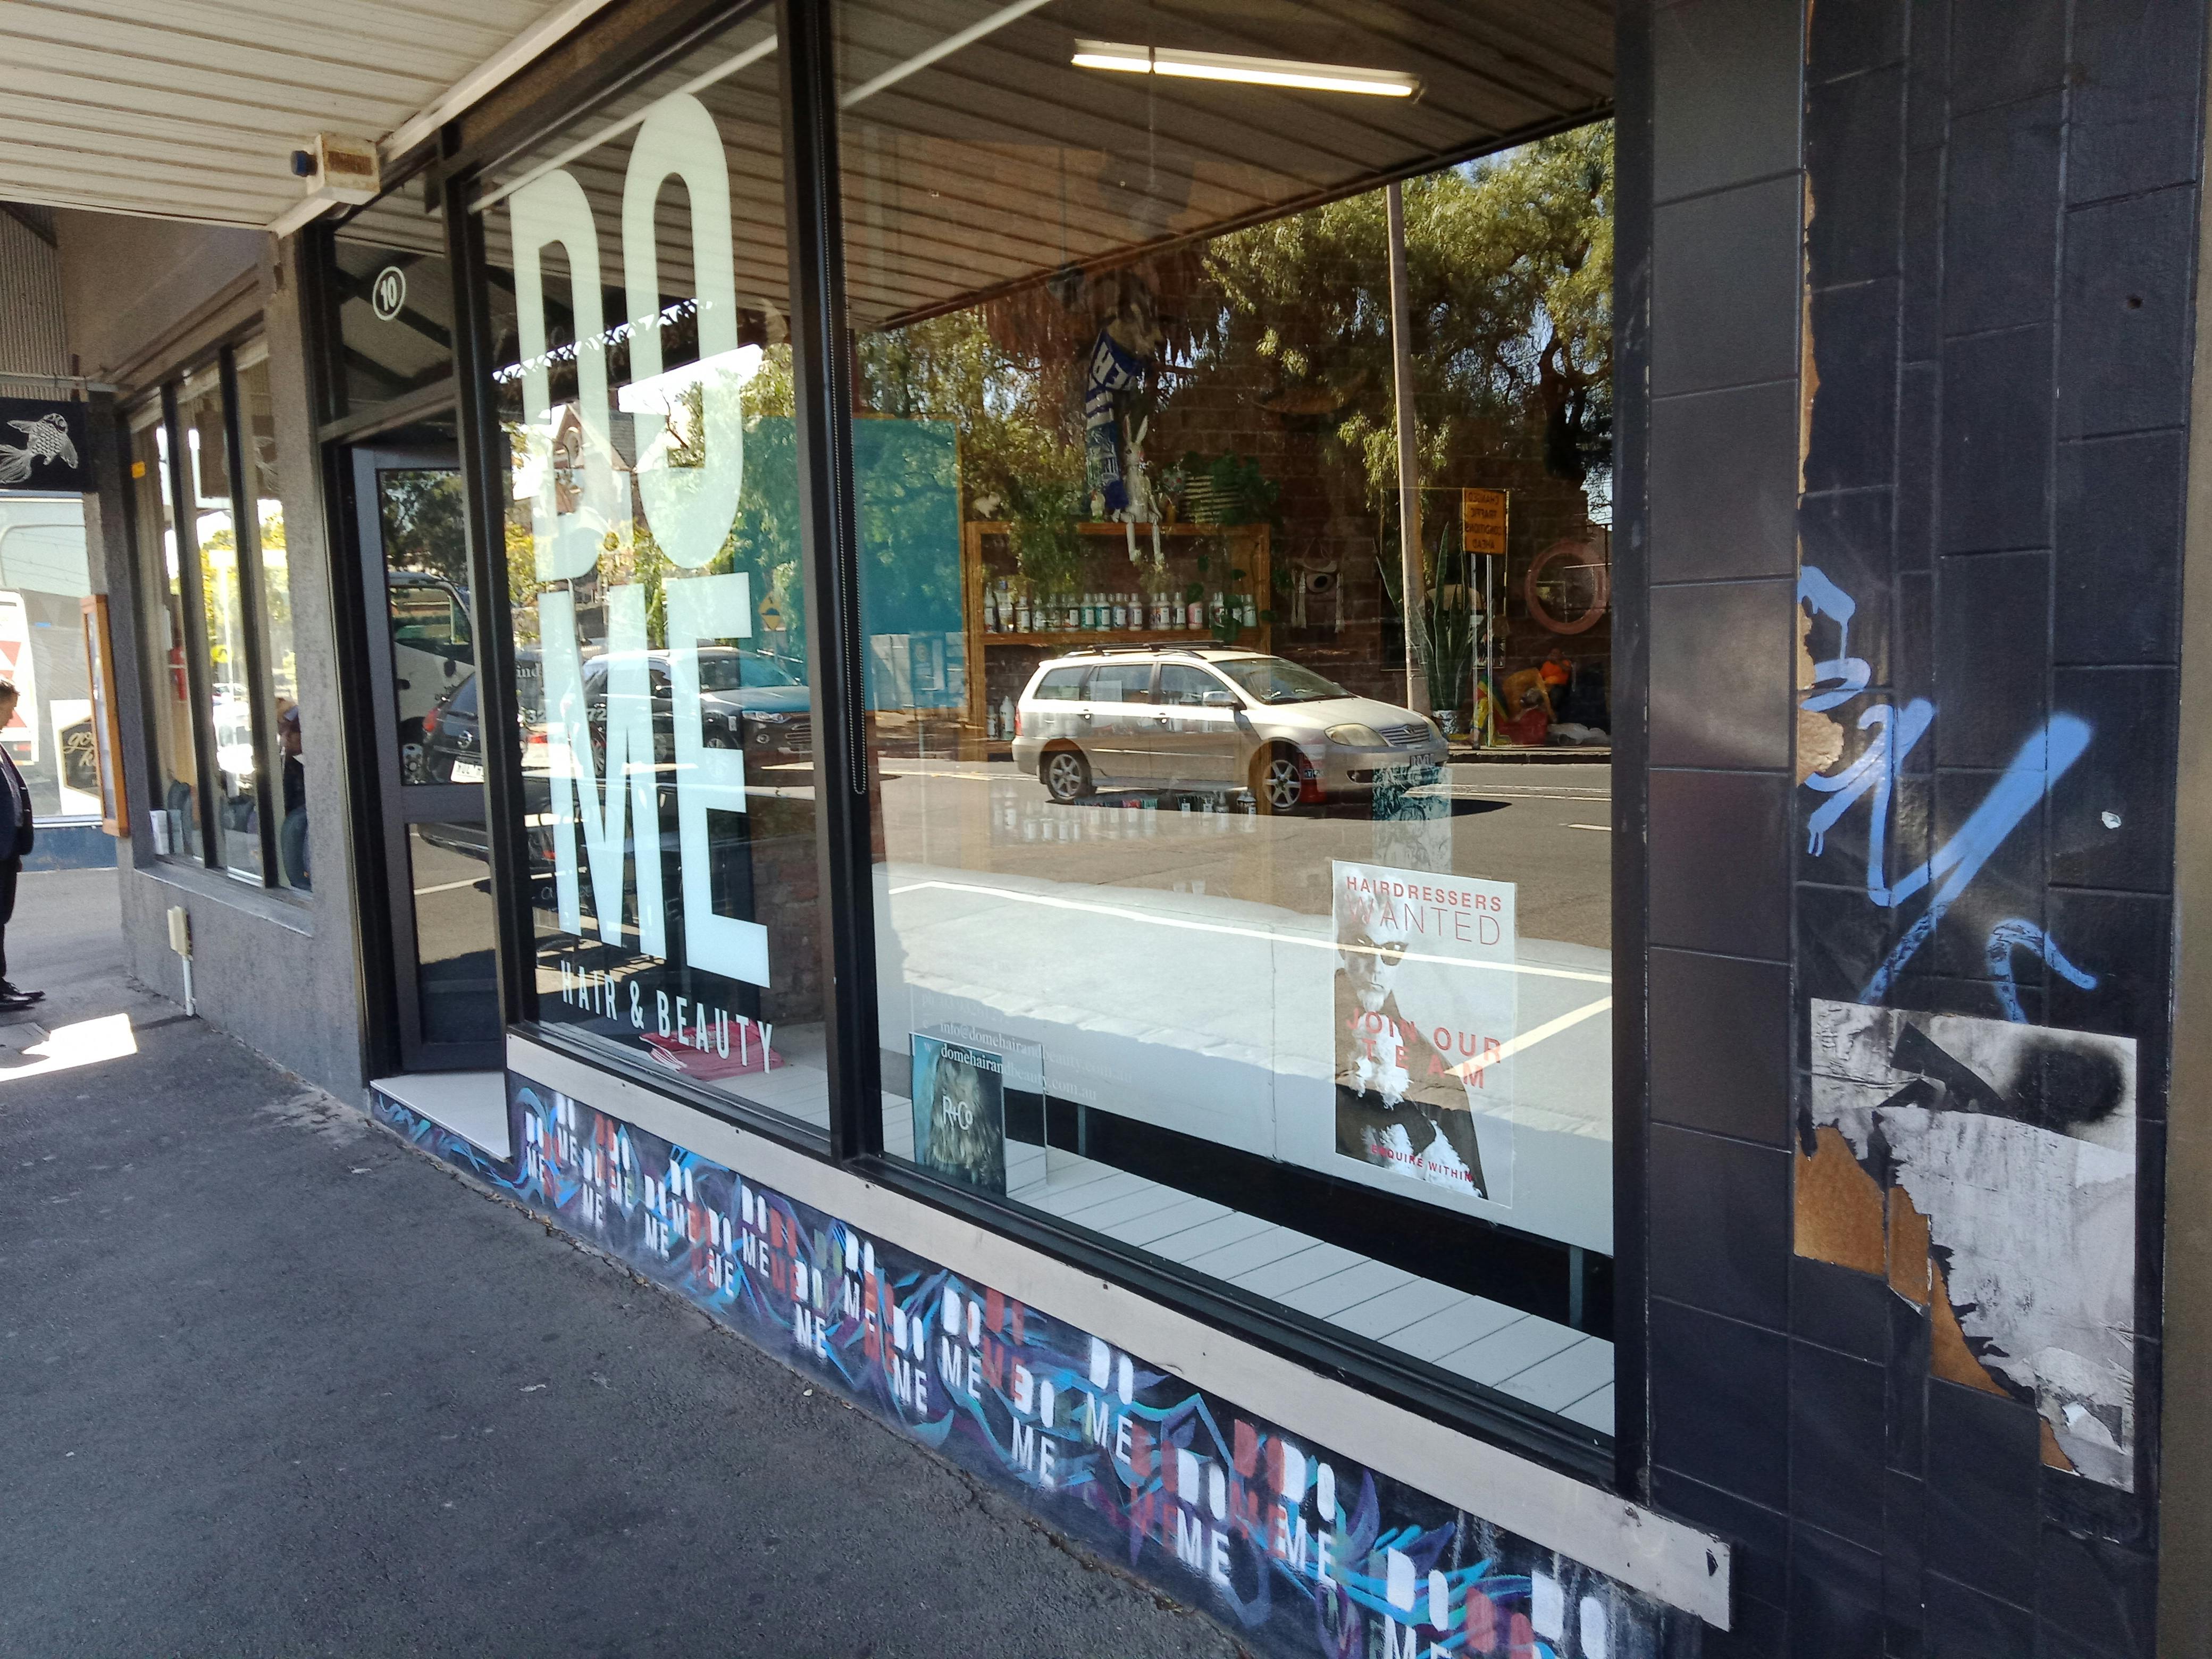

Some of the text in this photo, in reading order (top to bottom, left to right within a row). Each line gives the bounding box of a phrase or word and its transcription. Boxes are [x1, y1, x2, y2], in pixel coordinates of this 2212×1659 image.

[381, 276, 397, 311] 10
[538, 572, 770, 988] ME
[1346, 876, 1501, 912] HAIRDRESSERS
[1346, 894, 1499, 945] WANTED
[561, 960, 773, 1074] HAIR & BEAUTY
[1346, 1008, 1501, 1064] JOIN OUR
[941, 1043, 1096, 1101] domehairandbeauty.com.au
[1362, 1037, 1484, 1089] TEAM
[1428, 1161, 1474, 1182] WITHIN
